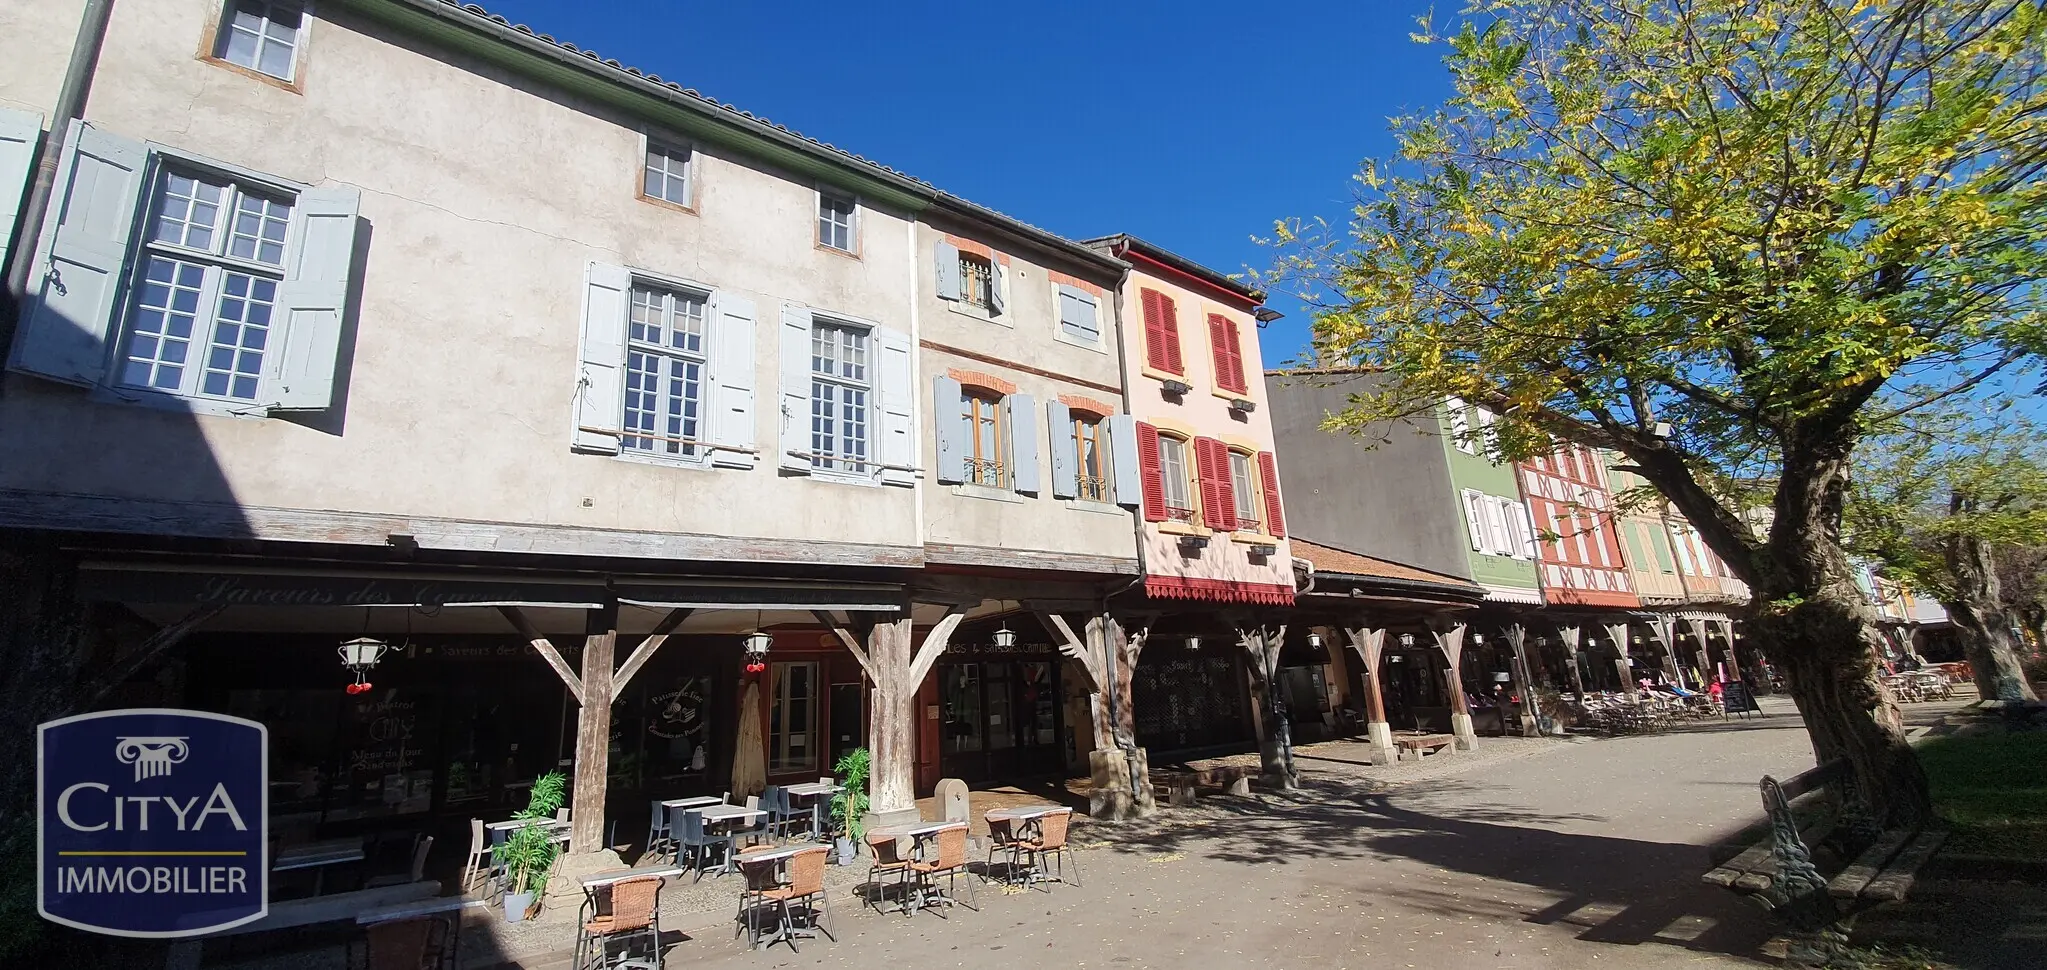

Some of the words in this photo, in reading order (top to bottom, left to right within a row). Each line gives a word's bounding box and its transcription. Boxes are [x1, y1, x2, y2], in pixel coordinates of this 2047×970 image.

[195, 576, 334, 603] Saveurs
[346, 579, 391, 603] des
[440, 644, 490, 656] Saveurs
[496, 643, 518, 656] des
[947, 643, 966, 654] Les
